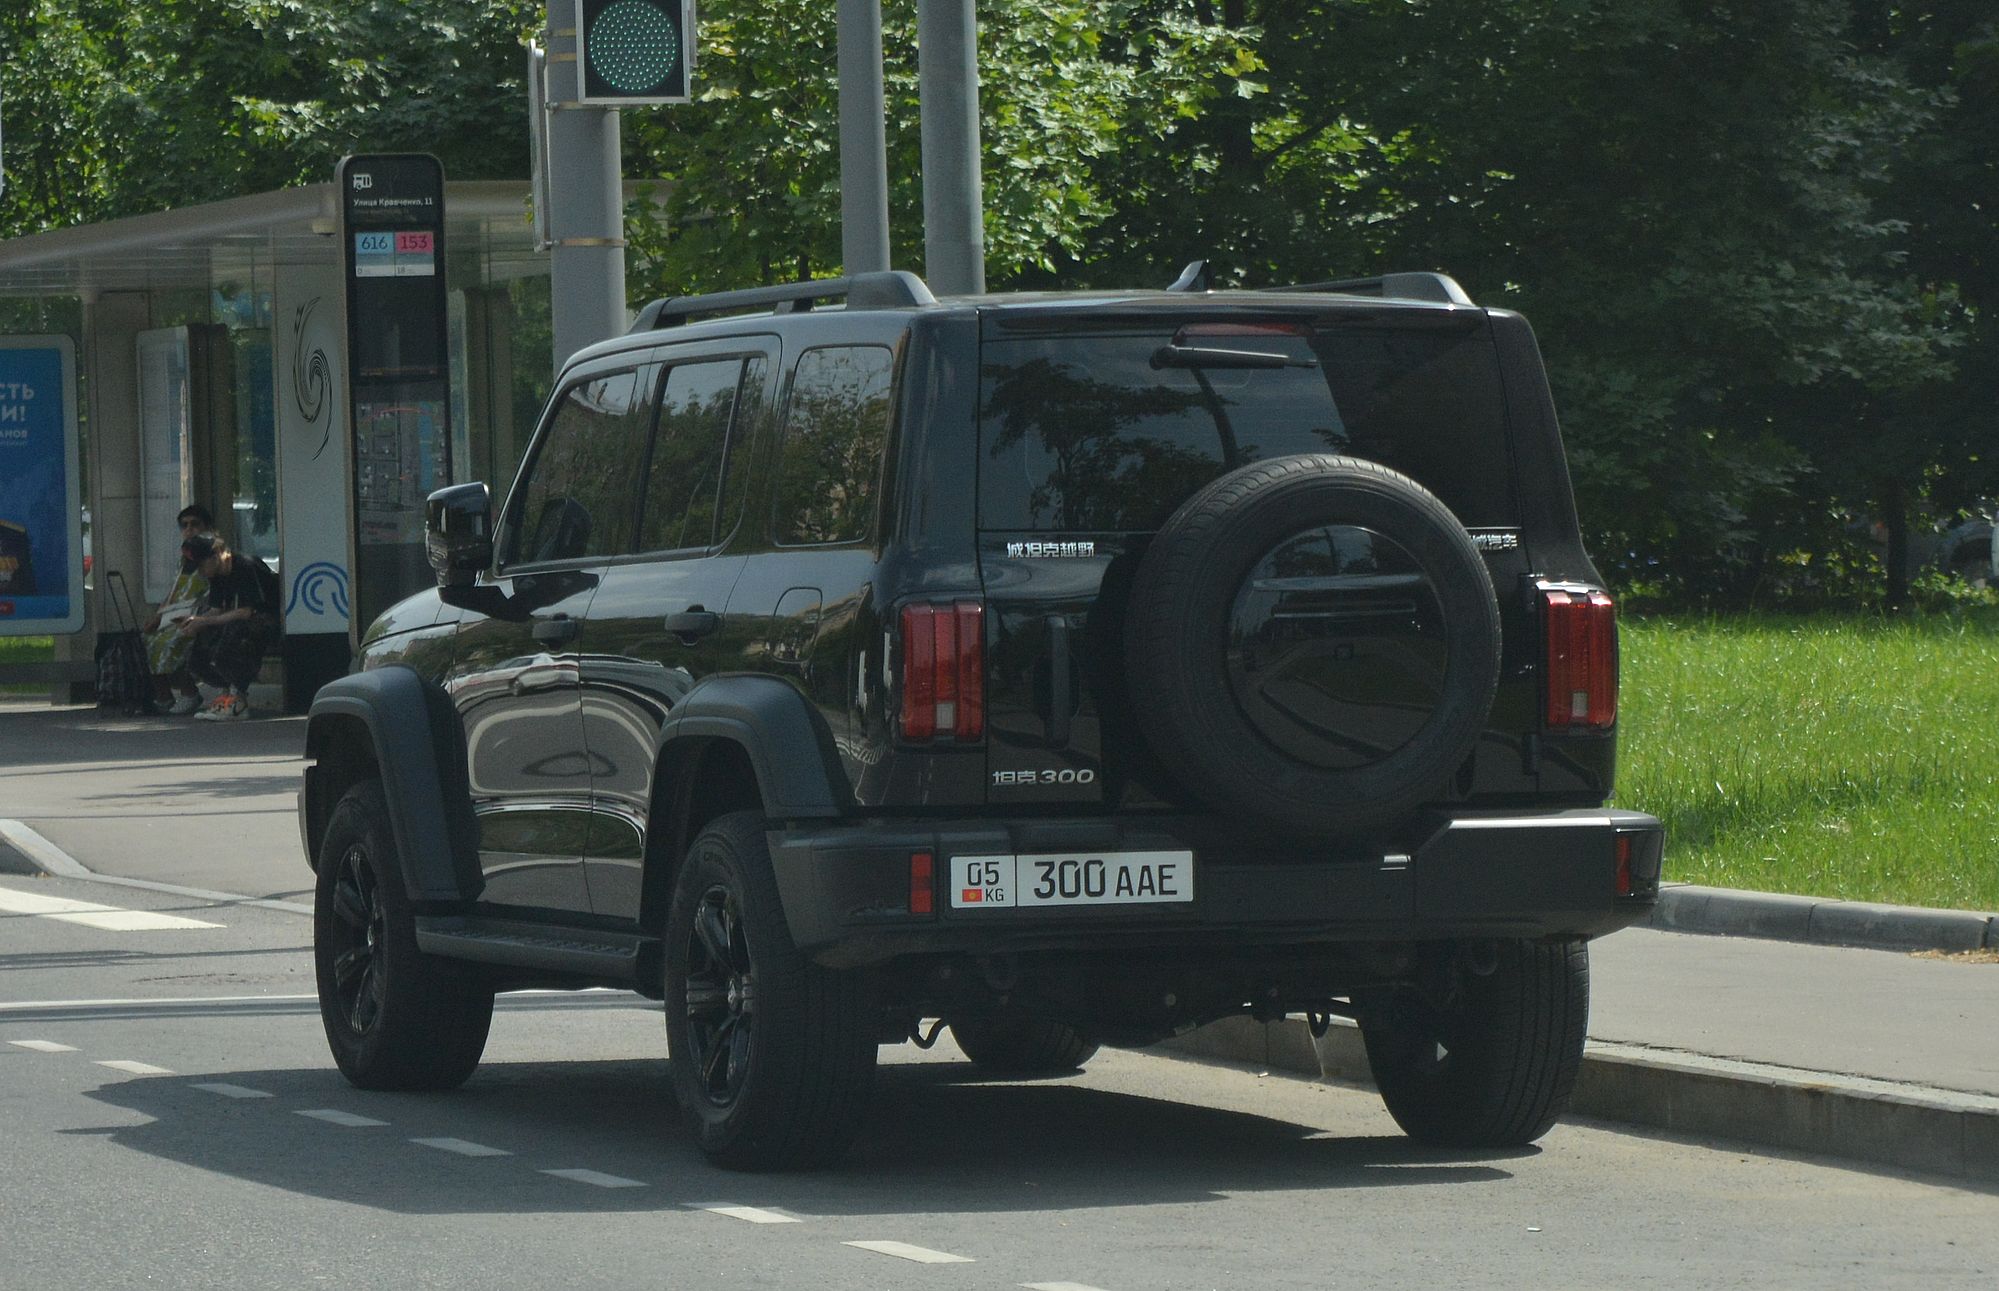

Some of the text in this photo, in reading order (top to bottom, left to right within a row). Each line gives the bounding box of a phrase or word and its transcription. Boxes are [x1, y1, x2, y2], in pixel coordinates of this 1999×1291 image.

[354, 198, 377, 207] Улица
[425, 197, 433, 206] 11
[361, 236, 388, 250] 616
[400, 236, 428, 250] 153
[967, 861, 1000, 886] 05
[1033, 859, 1178, 899] 300 AAE
[985, 888, 1004, 902] KG
